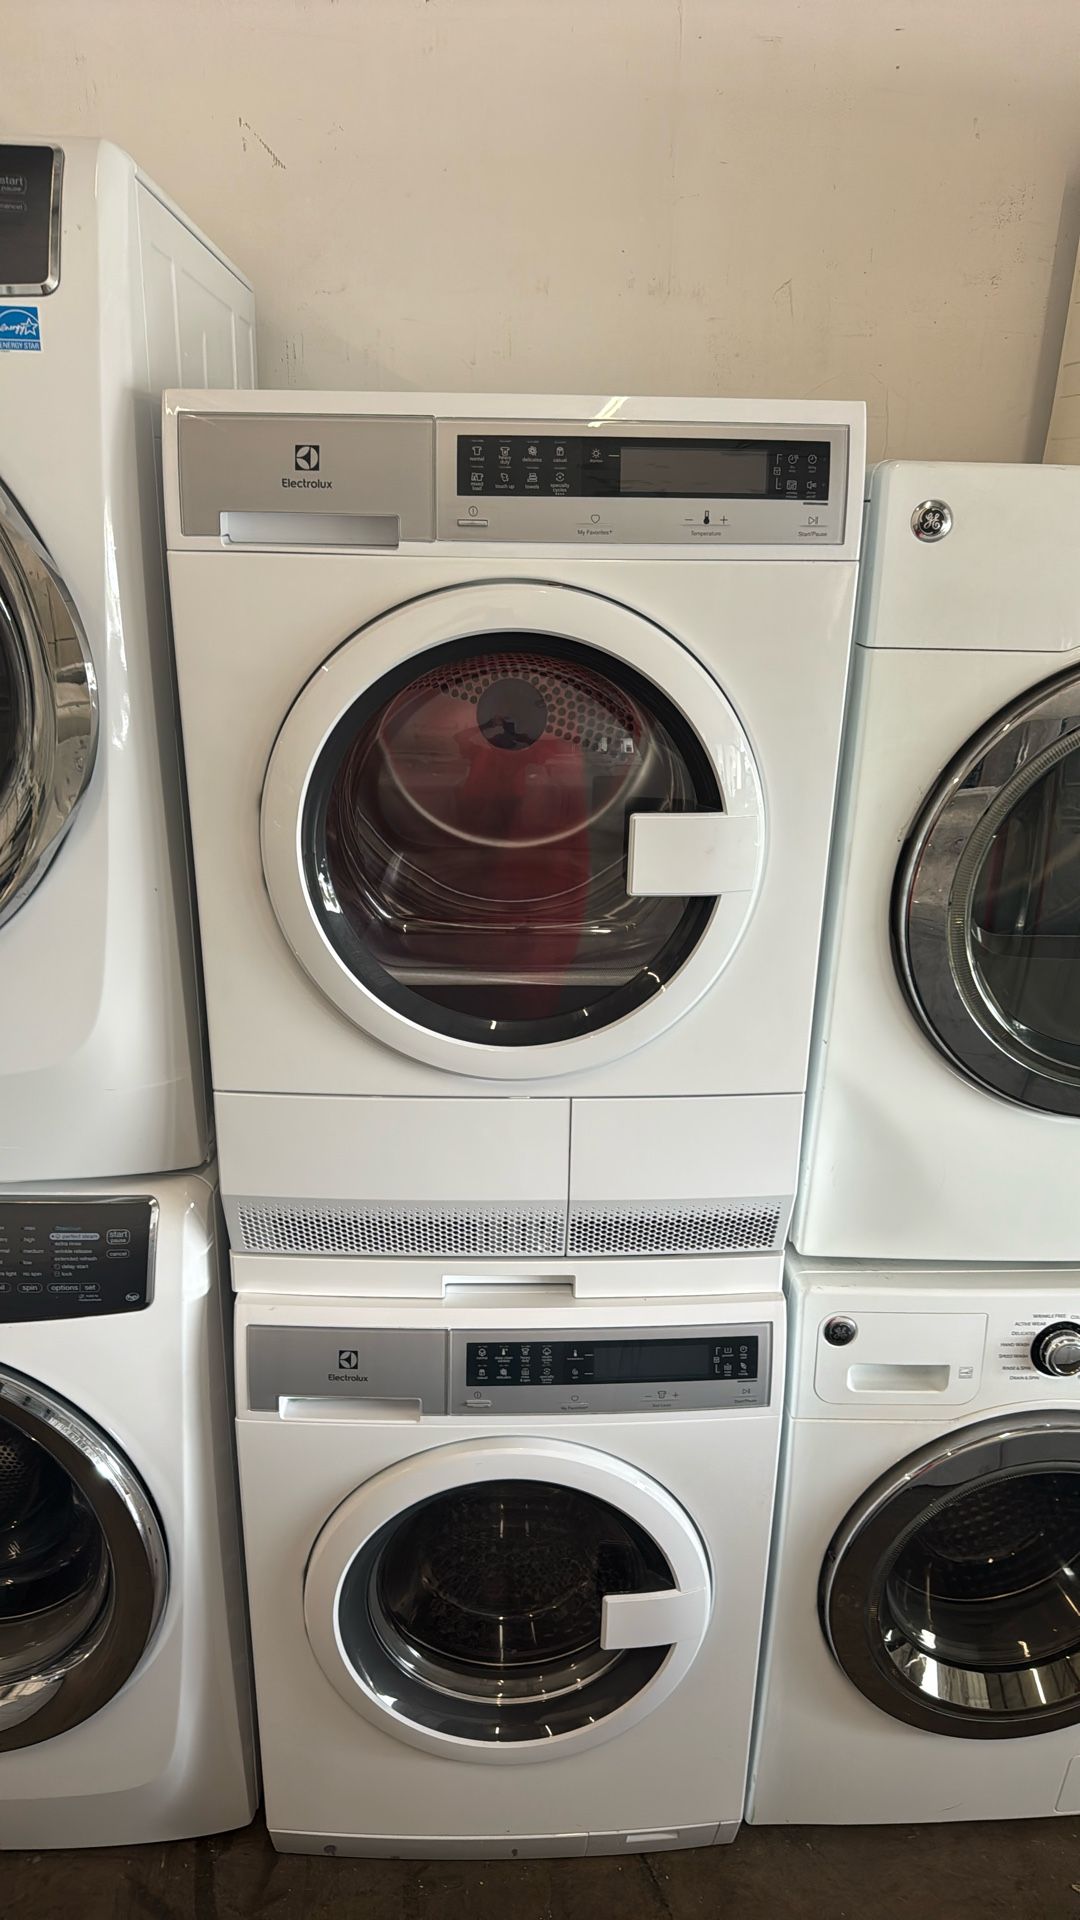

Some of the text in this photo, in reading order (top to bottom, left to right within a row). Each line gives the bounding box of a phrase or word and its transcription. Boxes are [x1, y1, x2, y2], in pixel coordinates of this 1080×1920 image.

[281, 478, 333, 489] Electrolux
[109, 1230, 128, 1238] start
[51, 1284, 78, 1292] options
[327, 1373, 368, 1382] Electrolux
